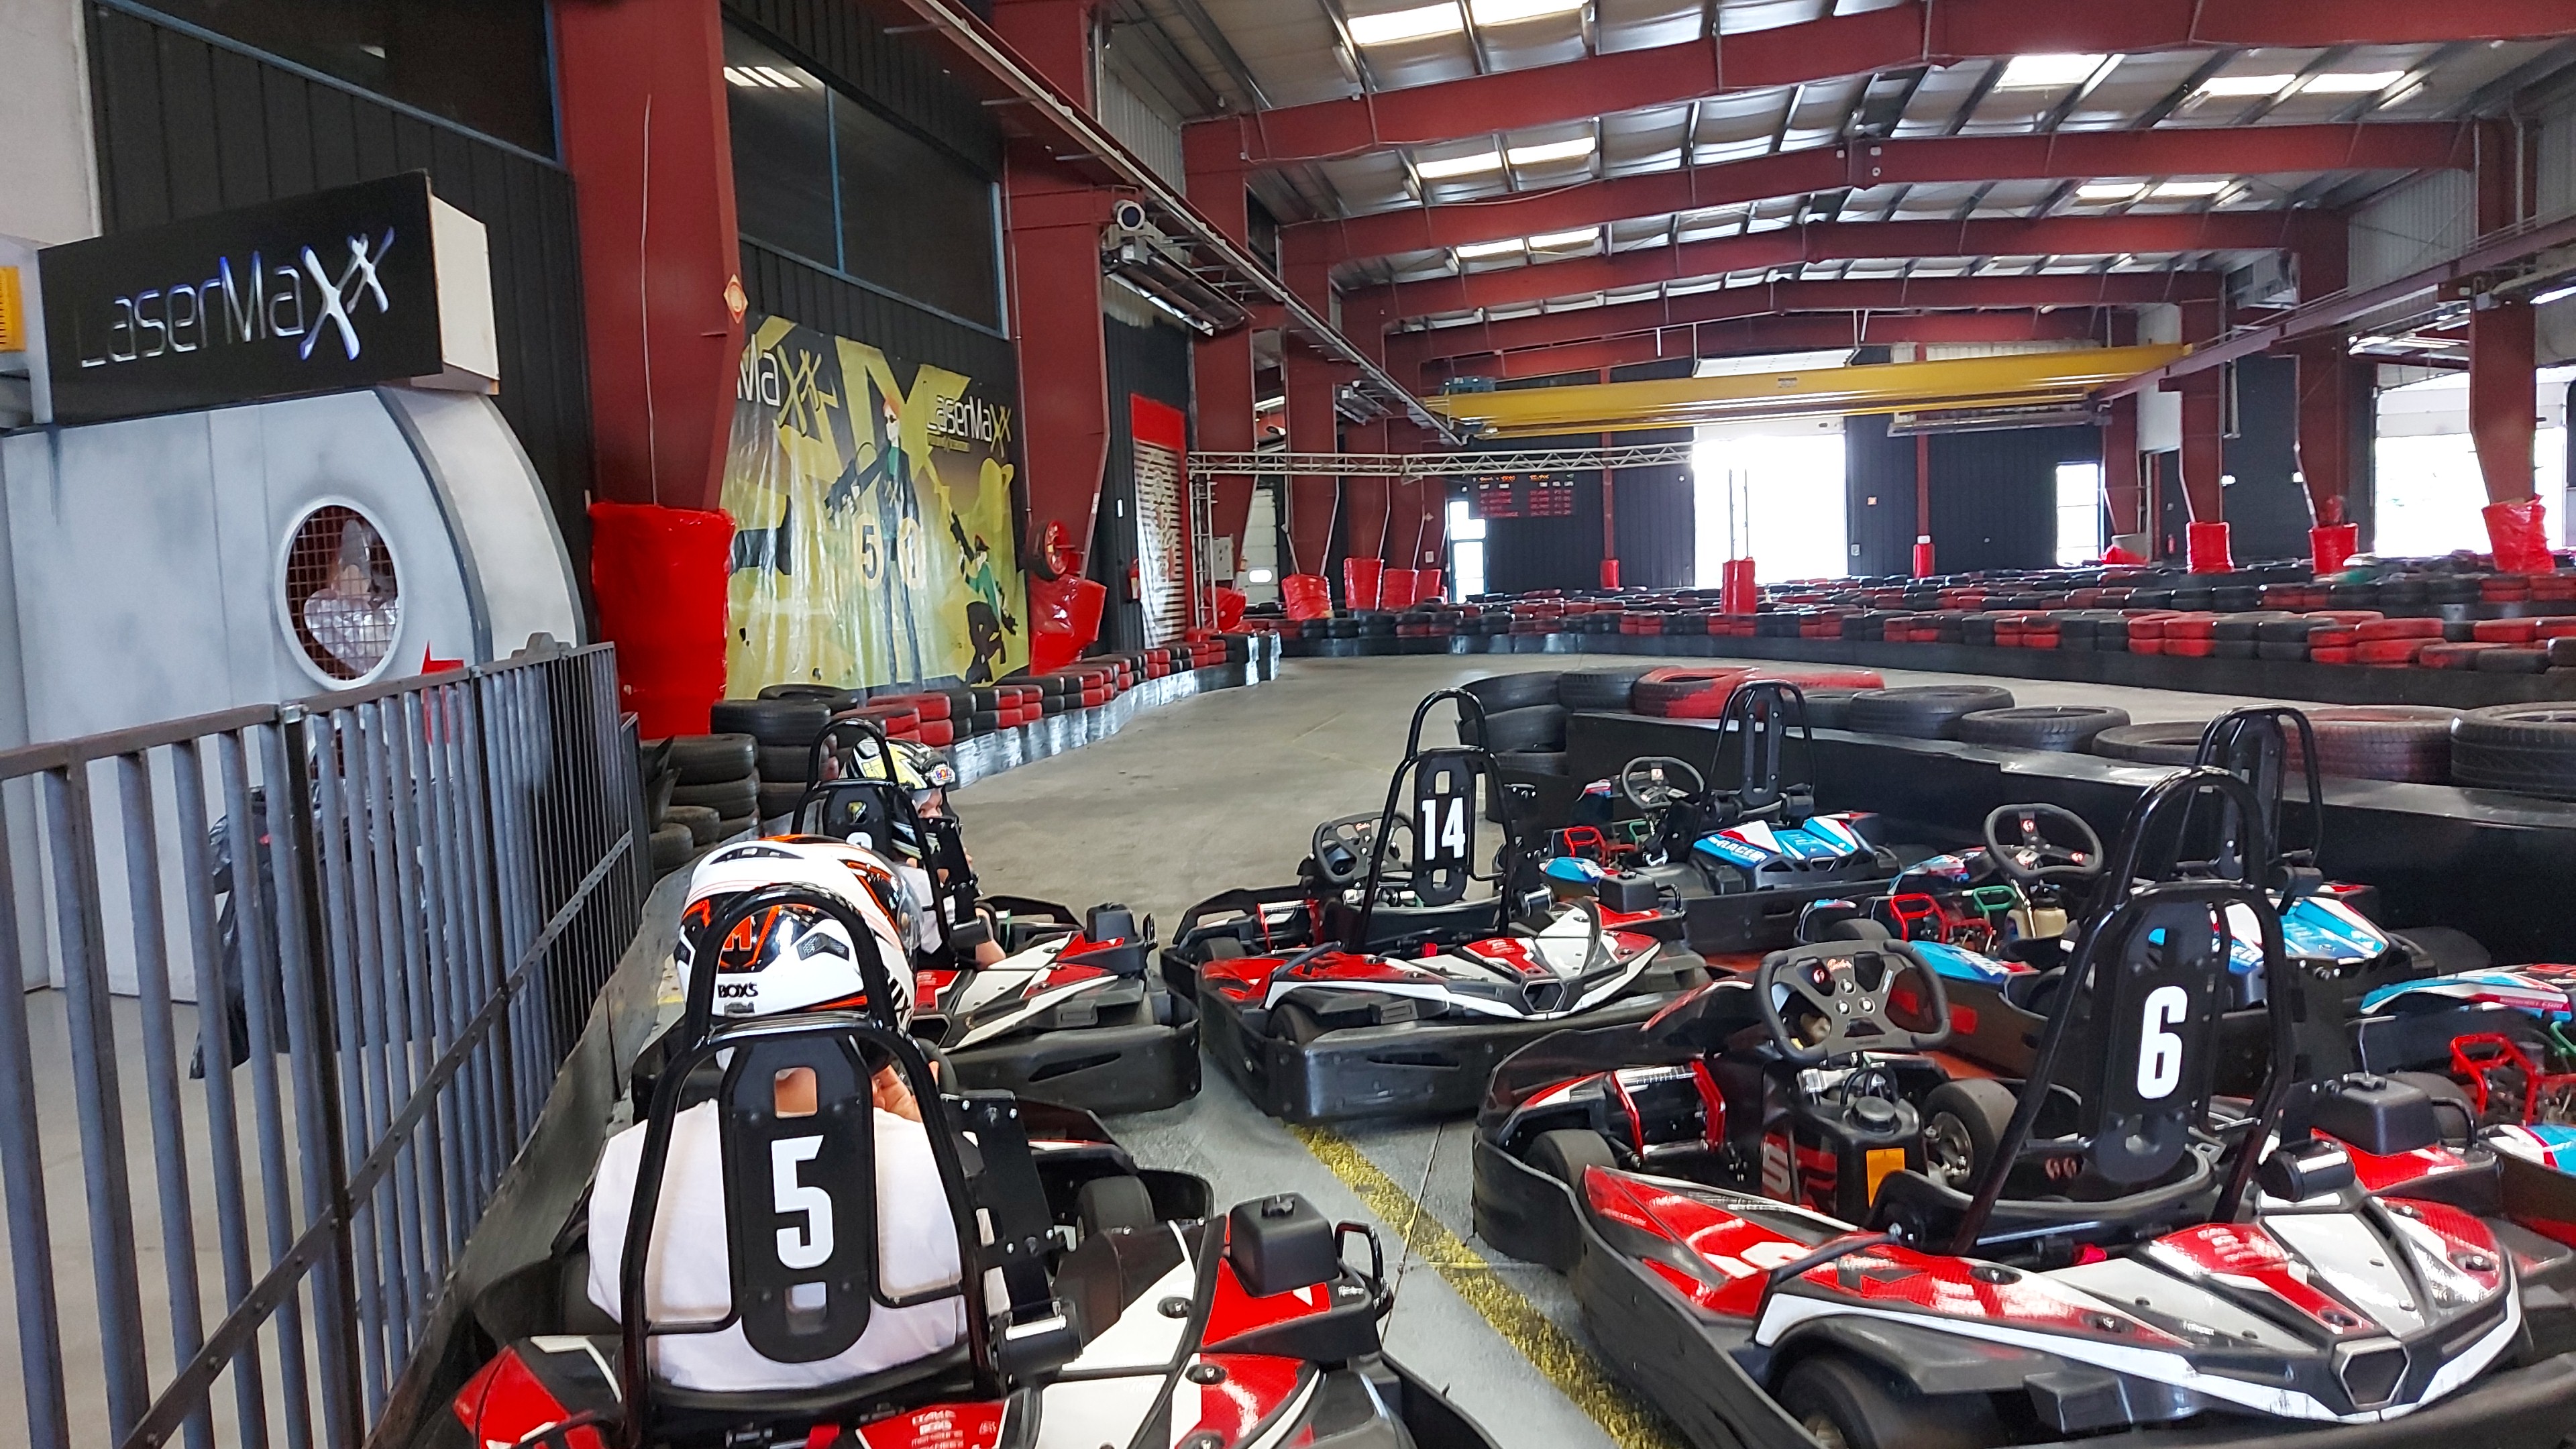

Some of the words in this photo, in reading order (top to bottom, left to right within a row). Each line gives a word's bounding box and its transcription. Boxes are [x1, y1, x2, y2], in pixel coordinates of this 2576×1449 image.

[862, 525, 877, 580] 5
[1421, 797, 1466, 861] 14
[2137, 986, 2188, 1099] 6
[771, 1134, 834, 1269] 5
